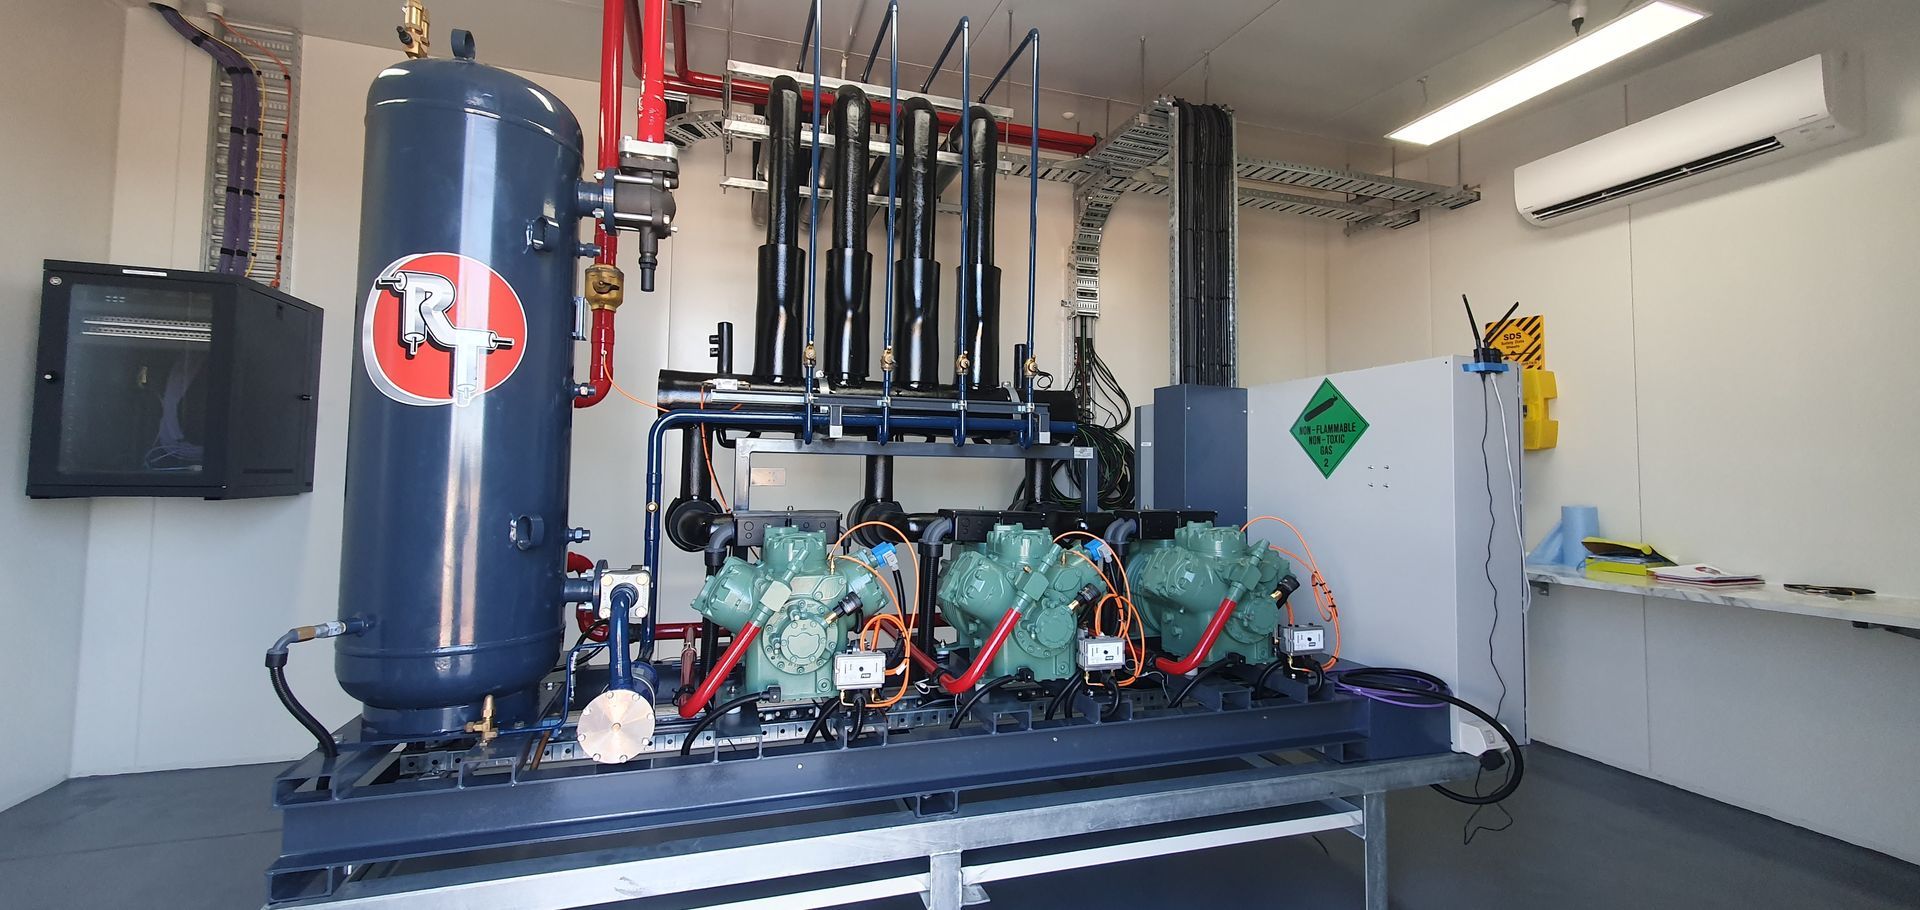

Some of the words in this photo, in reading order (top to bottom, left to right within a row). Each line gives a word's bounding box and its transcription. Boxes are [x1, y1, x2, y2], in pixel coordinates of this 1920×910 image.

[1503, 332, 1522, 341] SDS
[1299, 422, 1356, 435] NON-FLAMMABLE
[1308, 433, 1345, 445] NON-TOXIC
[1320, 445, 1333, 455] GAS
[1323, 458, 1329, 468] 2
